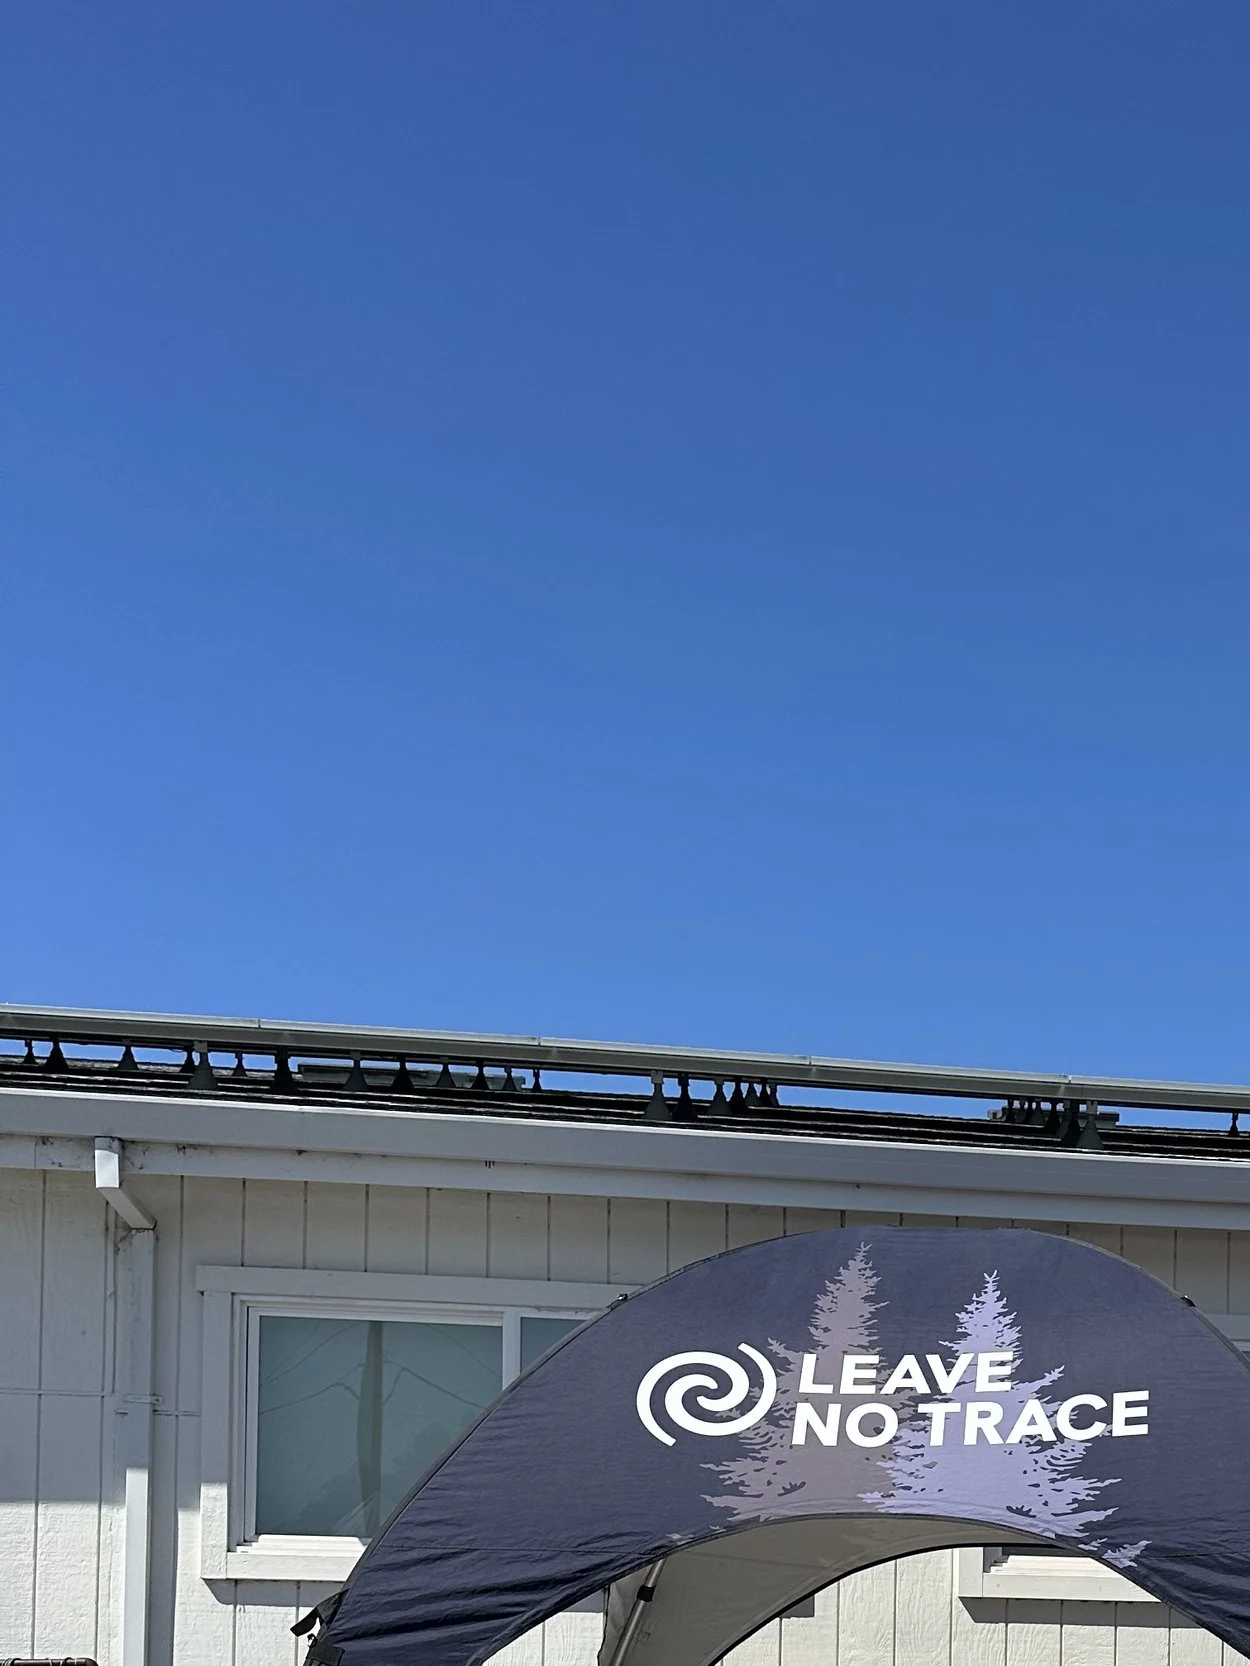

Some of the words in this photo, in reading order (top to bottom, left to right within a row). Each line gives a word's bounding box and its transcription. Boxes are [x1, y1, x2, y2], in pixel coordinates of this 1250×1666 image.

[799, 1351, 1014, 1395] LEAVE
[791, 1402, 899, 1448] NO
[917, 1389, 1149, 1447] TRACE
